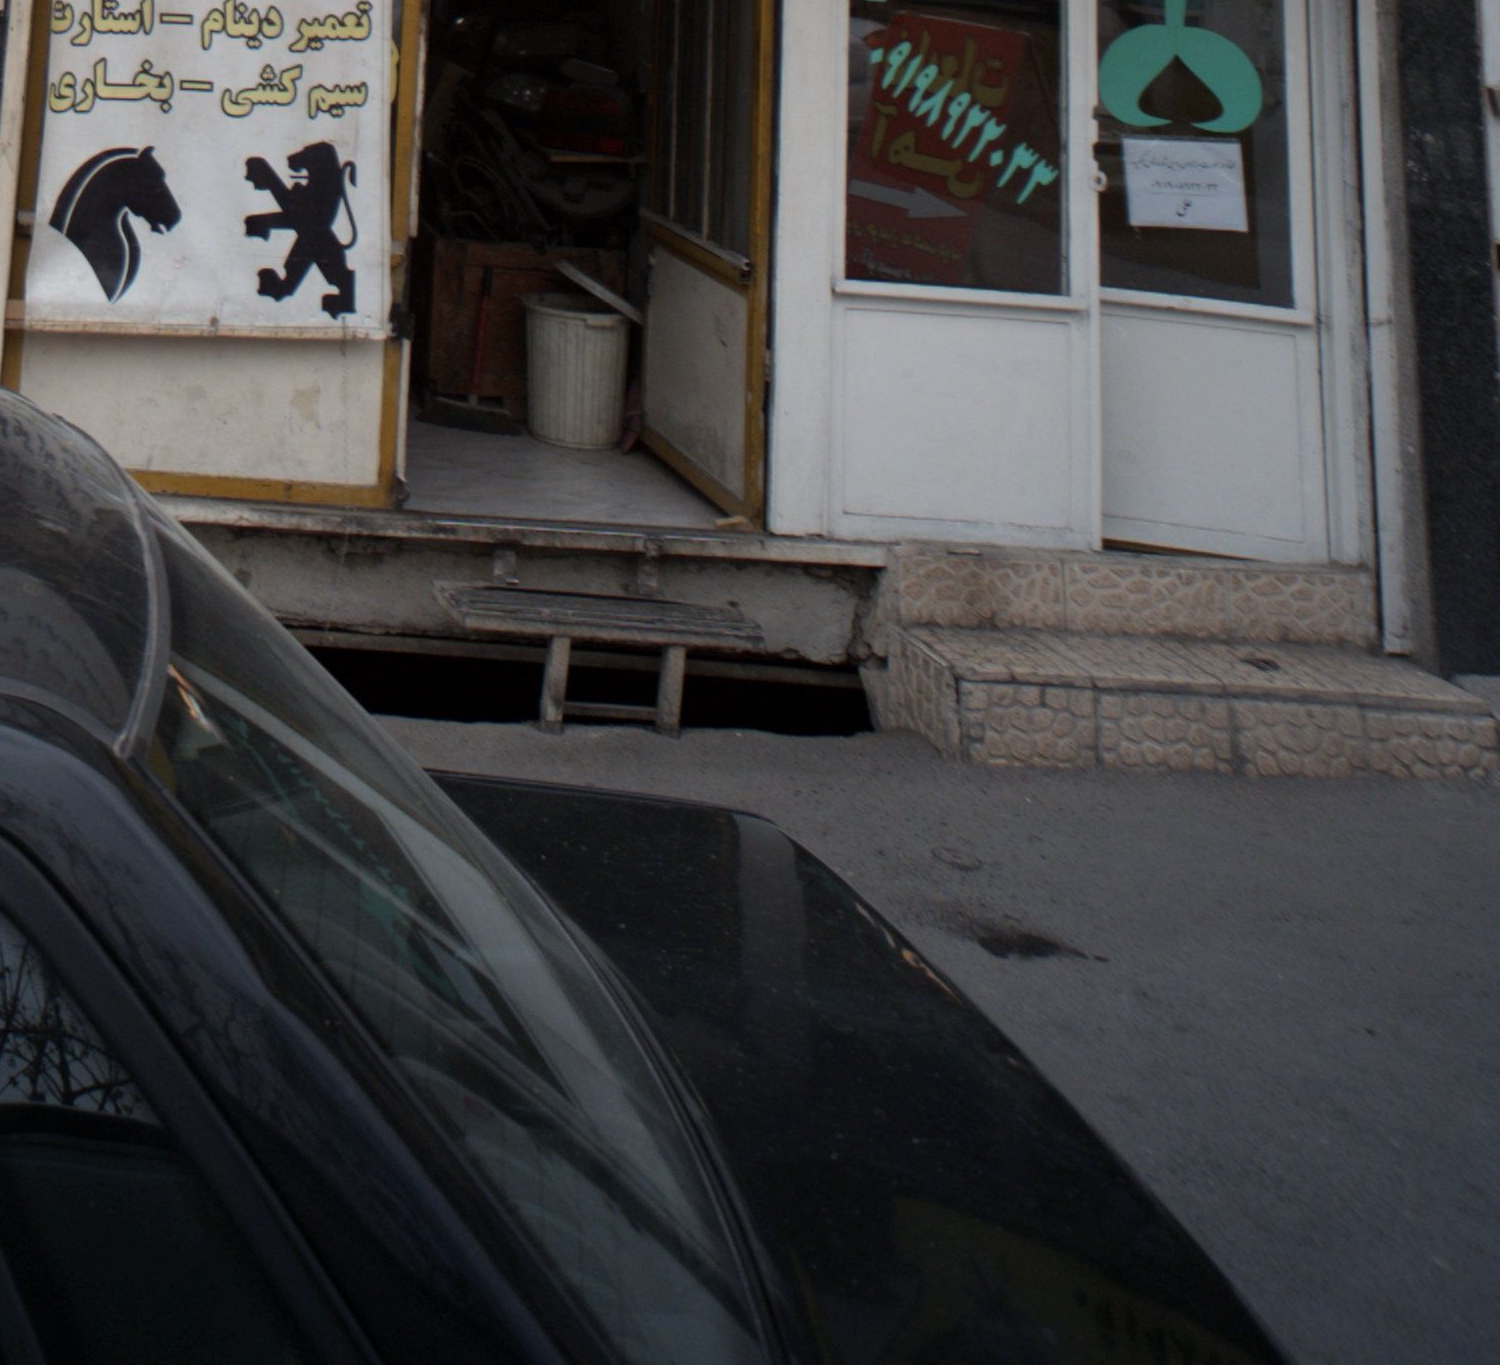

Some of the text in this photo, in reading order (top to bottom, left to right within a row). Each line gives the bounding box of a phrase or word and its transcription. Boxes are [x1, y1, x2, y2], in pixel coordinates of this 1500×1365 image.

[288, 0, 373, 53] تعمیر
[49, 57, 174, 113] بخاری
[221, 63, 303, 118] کشی
[307, 81, 368, 120] سیم
